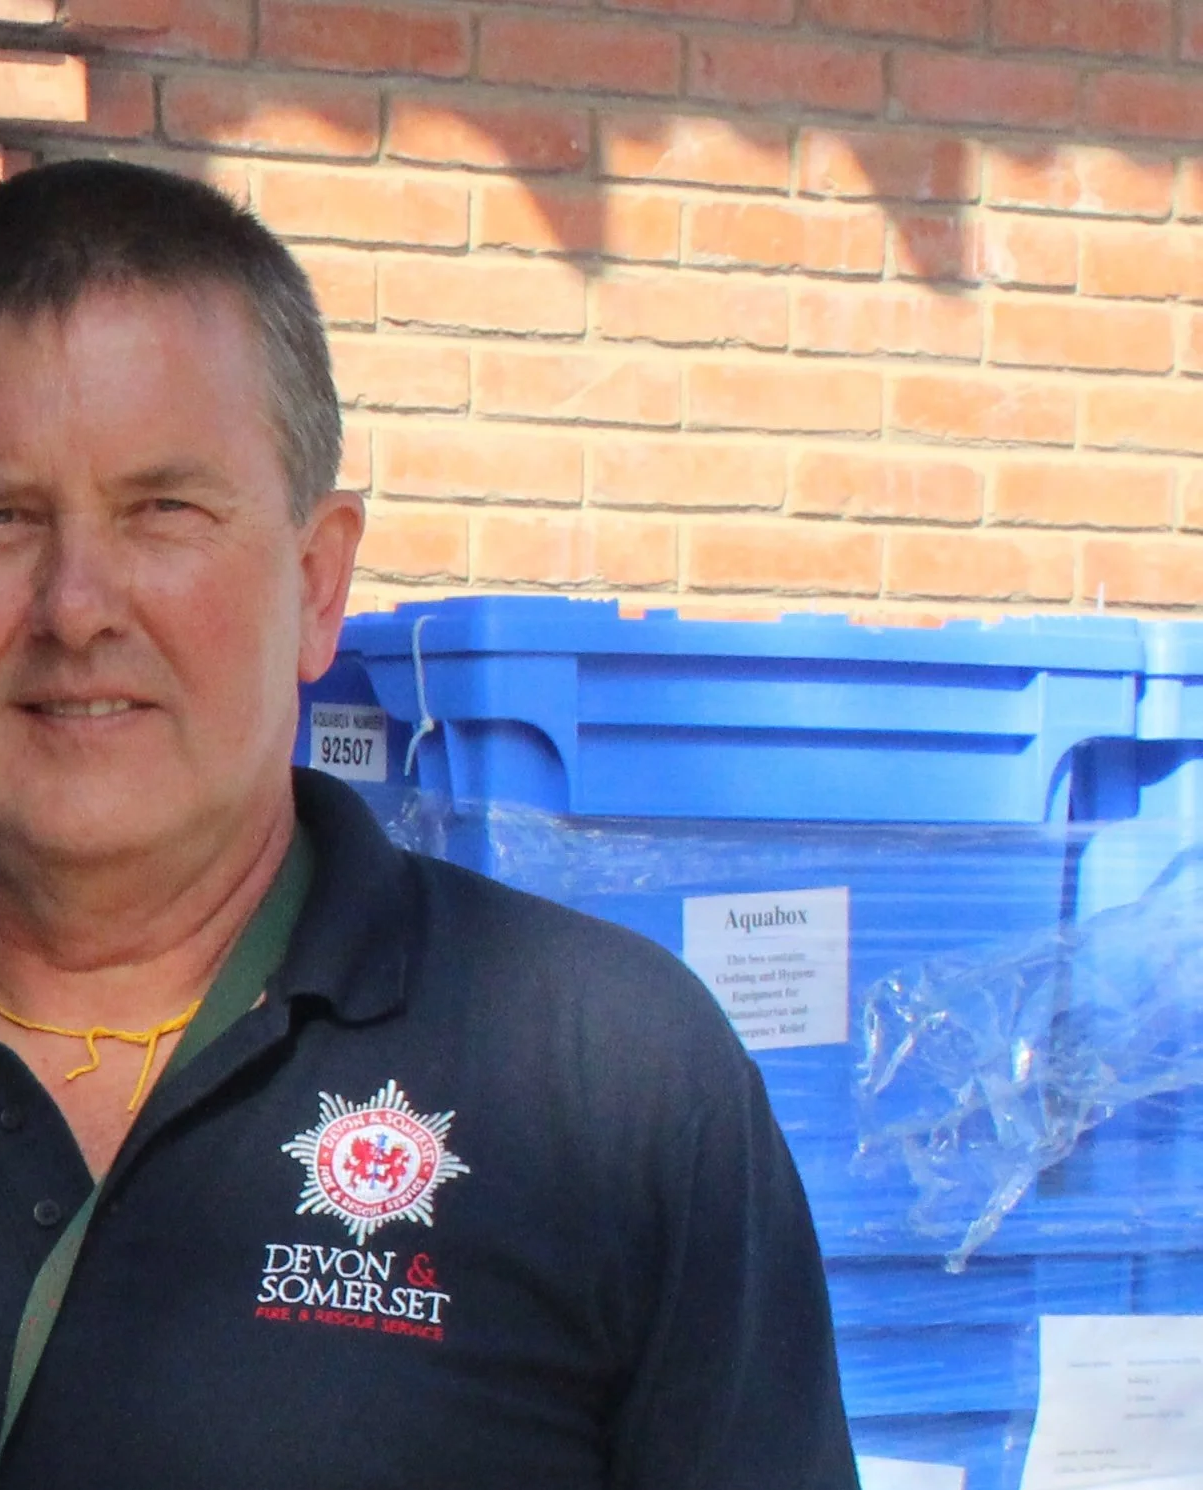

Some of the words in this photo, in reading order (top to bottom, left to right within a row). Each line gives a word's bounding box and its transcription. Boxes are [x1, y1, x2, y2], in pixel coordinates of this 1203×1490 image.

[321, 736, 374, 766] 92507
[725, 905, 809, 933] Aquabox
[738, 1026, 777, 1039] ergency
[262, 1244, 397, 1282] DEVON
[406, 1252, 442, 1288] &
[257, 1274, 451, 1324] SOMERSET
[255, 1306, 290, 1321] FIRE
[313, 1310, 376, 1329] RESCUE
[380, 1319, 444, 1342] SERVICE
